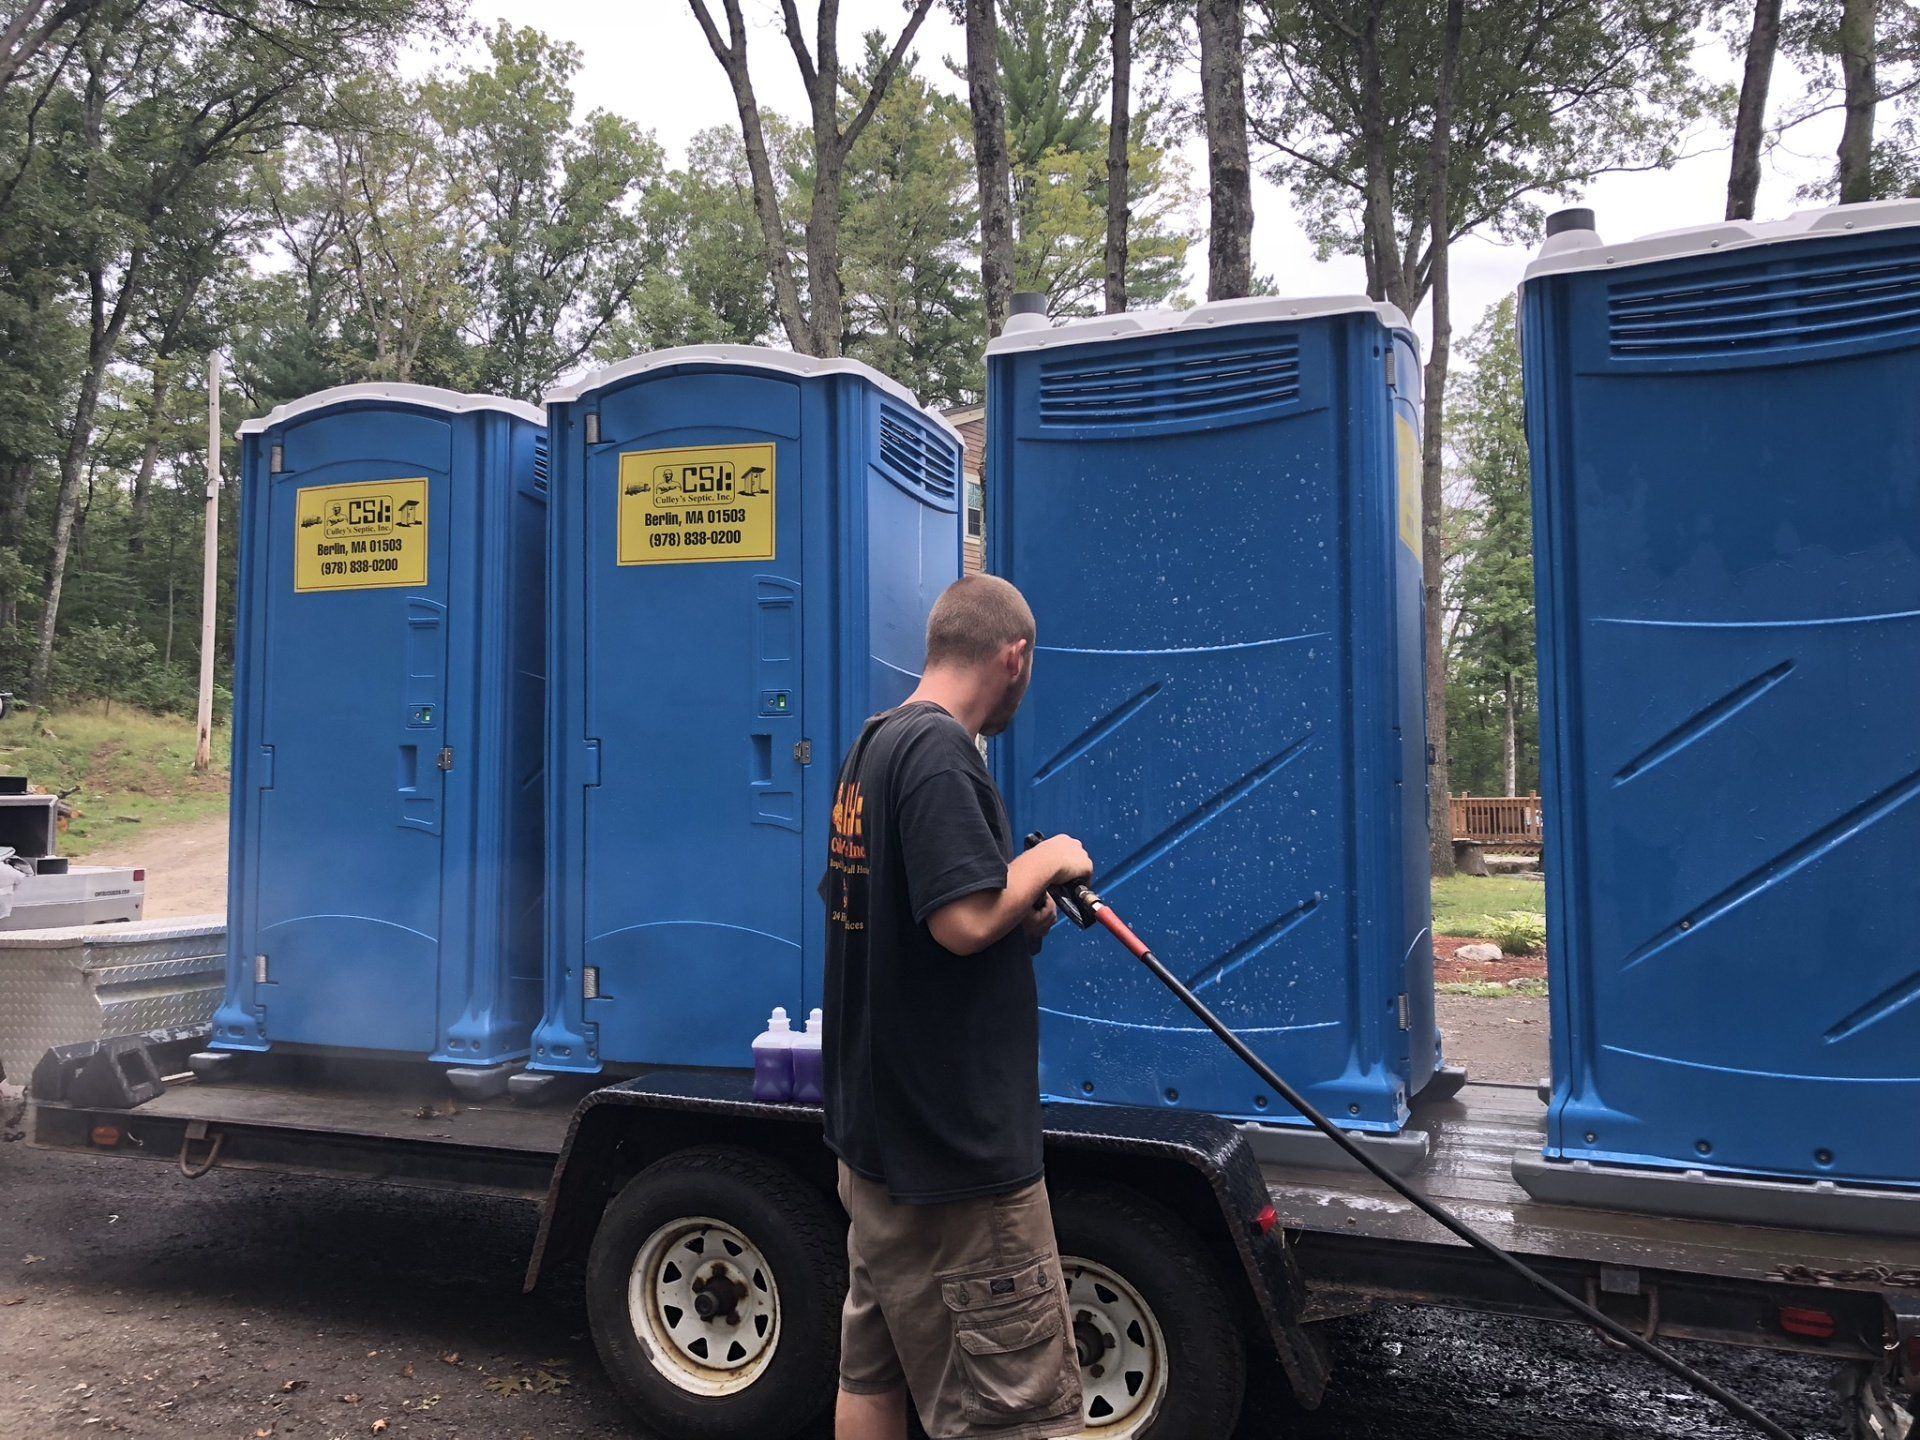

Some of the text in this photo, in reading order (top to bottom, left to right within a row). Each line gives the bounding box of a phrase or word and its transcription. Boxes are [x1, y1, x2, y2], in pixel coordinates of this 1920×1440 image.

[655, 495, 686, 504] Culley's
[717, 493, 732, 501] Inc.
[645, 509, 745, 527] Berlin, MA 01503
[317, 539, 402, 557] Berlin, MA 01503
[649, 530, 741, 548] (978) 838-0200
[321, 558, 398, 575] (978) 838-0200
